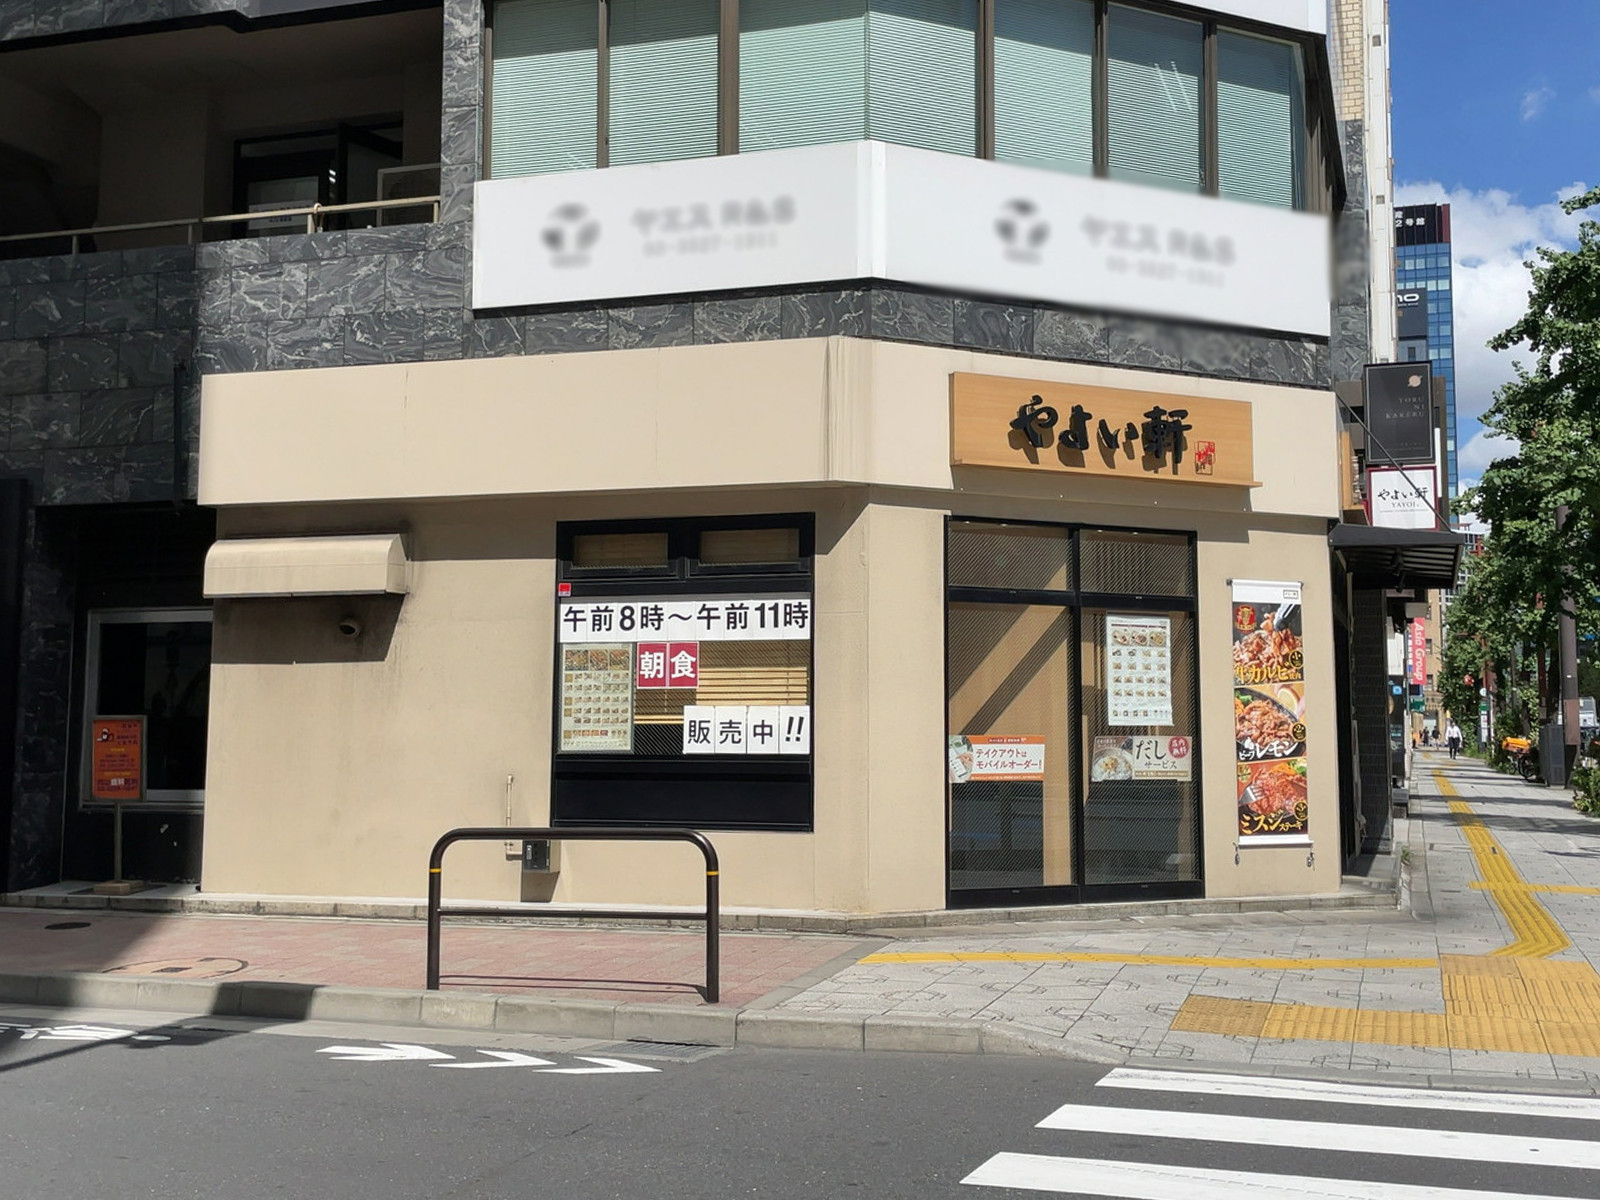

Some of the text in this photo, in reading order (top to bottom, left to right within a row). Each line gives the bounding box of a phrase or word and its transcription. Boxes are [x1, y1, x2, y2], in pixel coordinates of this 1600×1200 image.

[1009, 394, 1193, 464] やよい軒
[1414, 622, 1426, 681] Asia Group
[639, 650, 697, 680] 朝食
[975, 748, 1027, 758] テイクアウトは
[1136, 739, 1167, 760] だし
[1144, 760, 1178, 769] サービス
